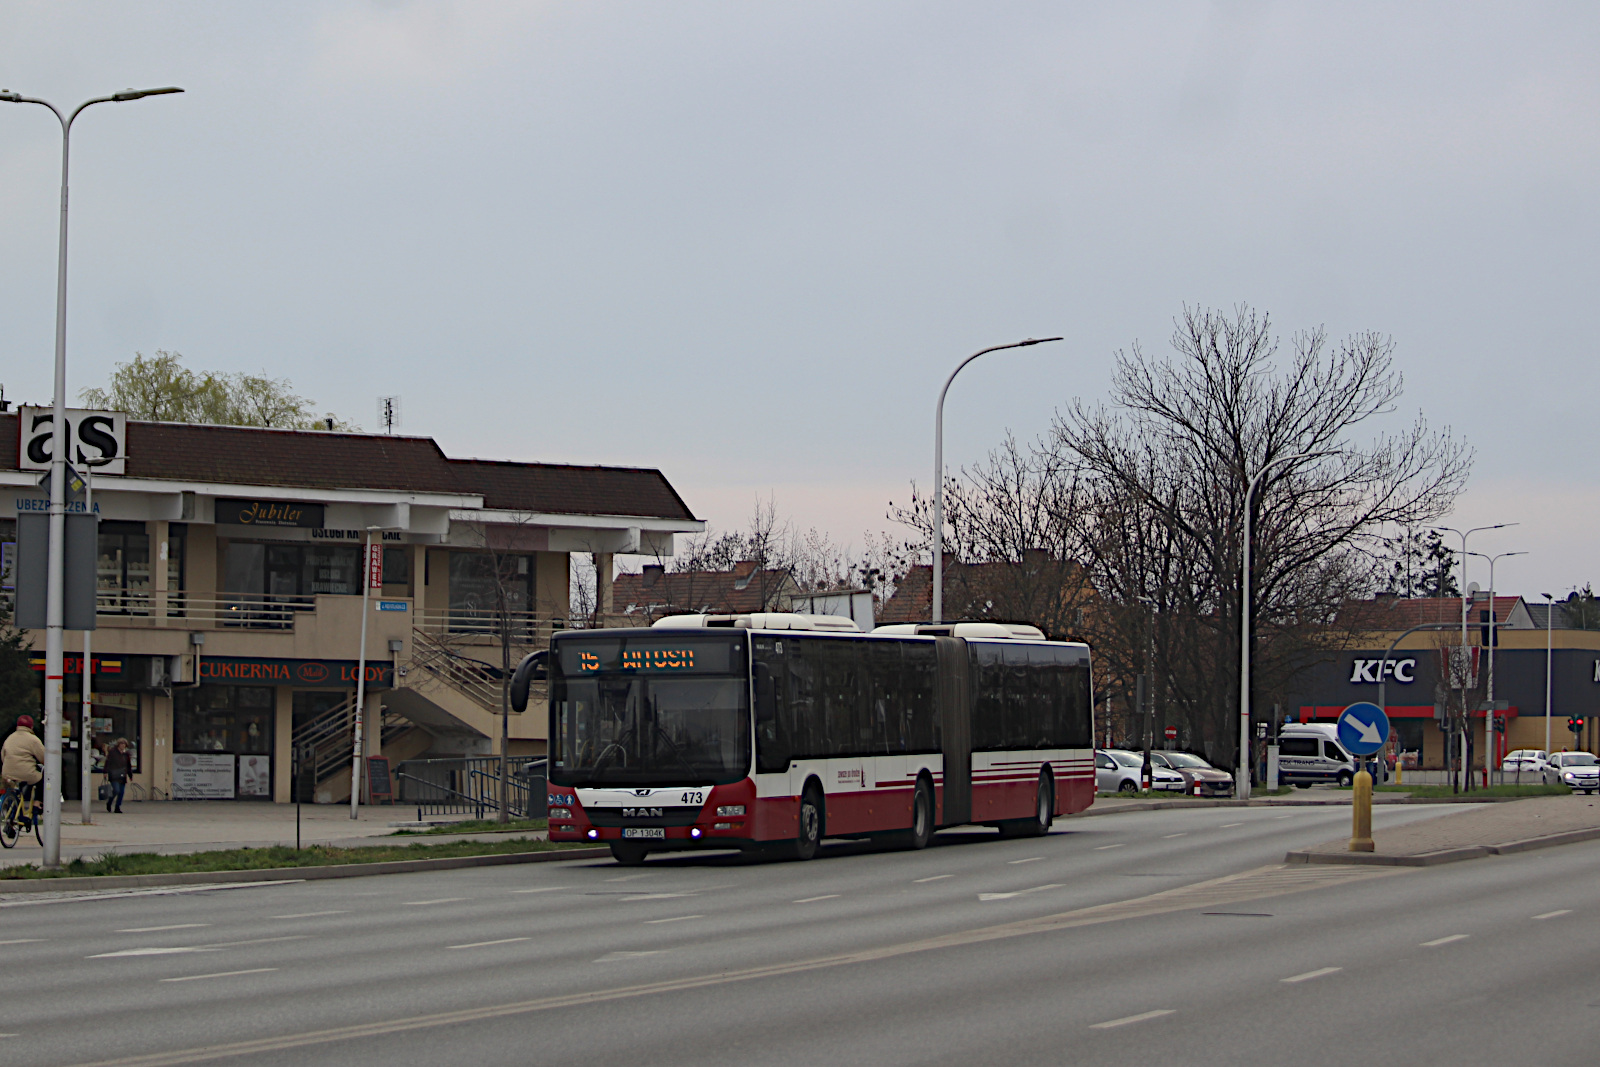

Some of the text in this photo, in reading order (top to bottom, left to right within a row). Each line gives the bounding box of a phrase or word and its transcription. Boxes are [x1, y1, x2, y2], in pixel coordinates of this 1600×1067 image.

[27, 414, 118, 466] as
[17, 498, 100, 513] UBEZPZENA
[239, 502, 303, 524] Jubiler
[63, 657, 100, 675] ERT
[198, 661, 291, 680] CUKIERNIA
[341, 666, 387, 682] LODY
[1350, 659, 1416, 683] KFC
[681, 791, 703, 804] 473
[622, 807, 664, 818] MAN
[626, 829, 663, 838] OP 1304K
